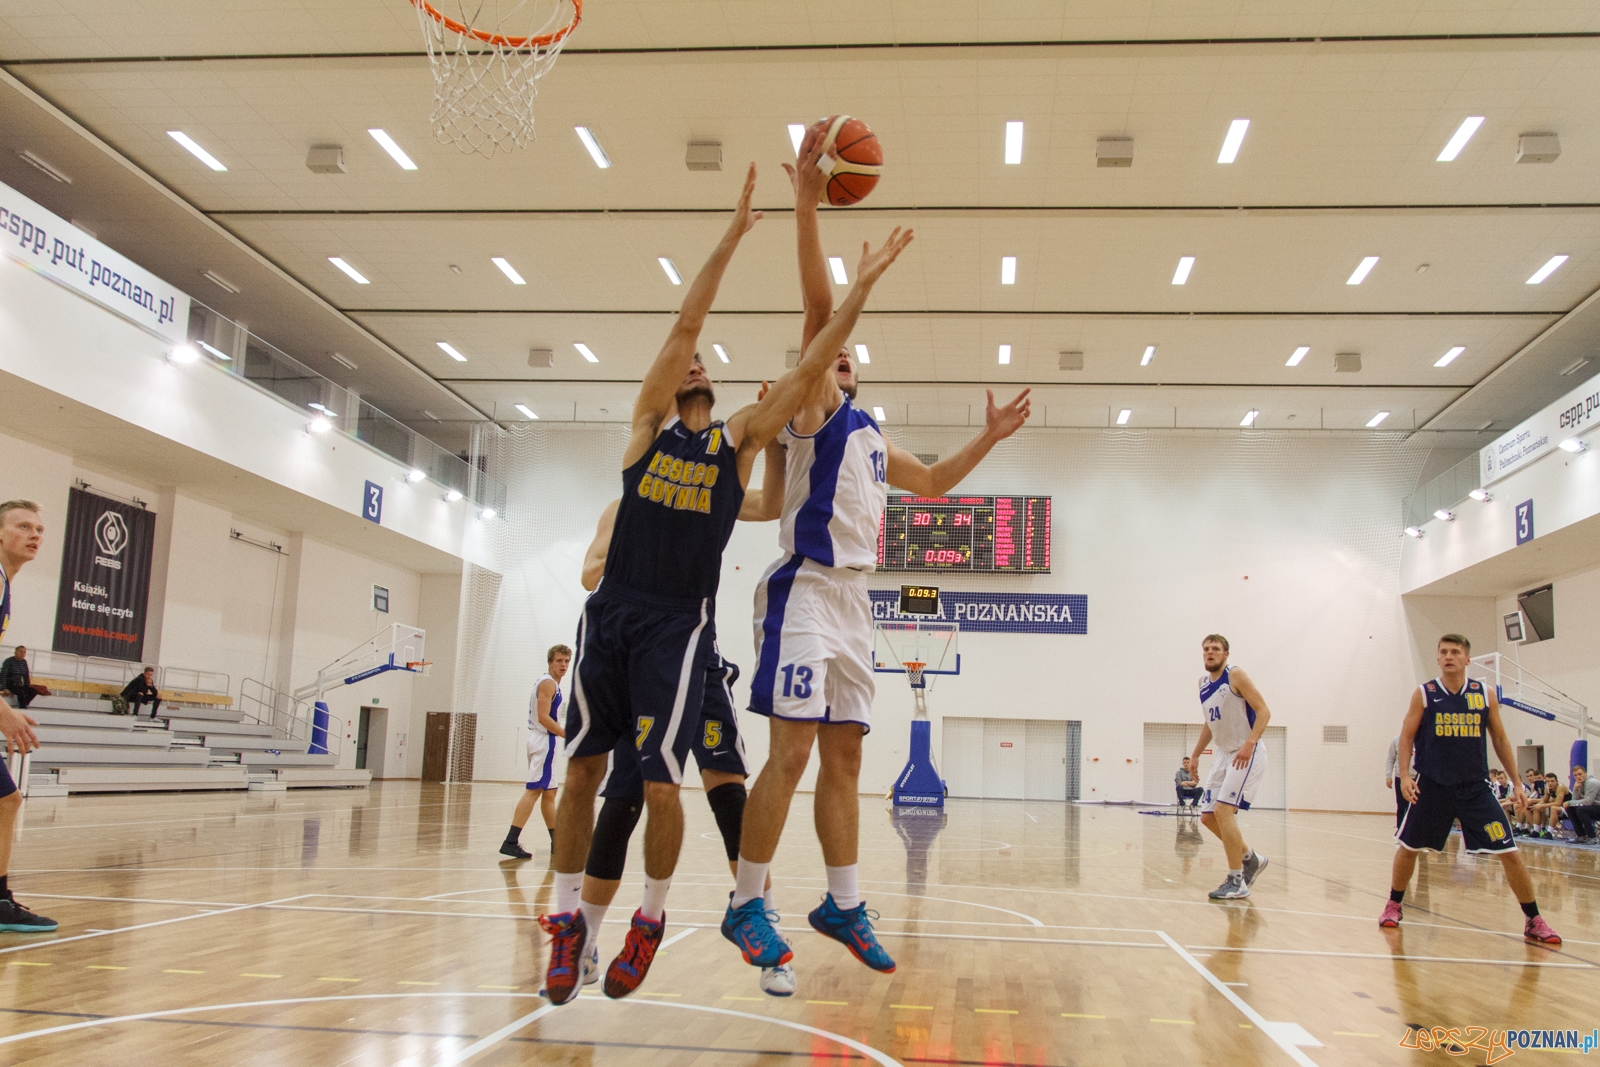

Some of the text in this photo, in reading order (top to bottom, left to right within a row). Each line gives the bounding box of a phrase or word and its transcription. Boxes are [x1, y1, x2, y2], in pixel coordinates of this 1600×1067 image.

[0, 206, 175, 324] cspp.put.poznan.pl
[1560, 391, 1600, 429] cspp.pu
[1499, 439, 1516, 455] Centrum
[647, 450, 719, 487] ASSECO
[869, 449, 886, 484] 13
[368, 486, 380, 518] 3
[638, 473, 712, 514] GDYNIA
[912, 513, 972, 526] 30 34
[1518, 505, 1529, 539] 3
[94, 556, 122, 570] REBIS
[73, 581, 108, 599] Książki,
[909, 588, 937, 598] 0.09.3
[71, 597, 134, 619] które się czyta
[954, 601, 1073, 623] POZNAŃSKA
[61, 623, 138, 644] www.rebis.com.pl
[780, 663, 813, 699] 13
[1465, 692, 1485, 710] 10
[1209, 706, 1222, 722] 24
[1435, 713, 1482, 725] ASSECO
[635, 716, 655, 750] 7
[703, 720, 722, 749] 5
[1435, 725, 1482, 737] GDYNIA
[1484, 821, 1506, 842] 10
